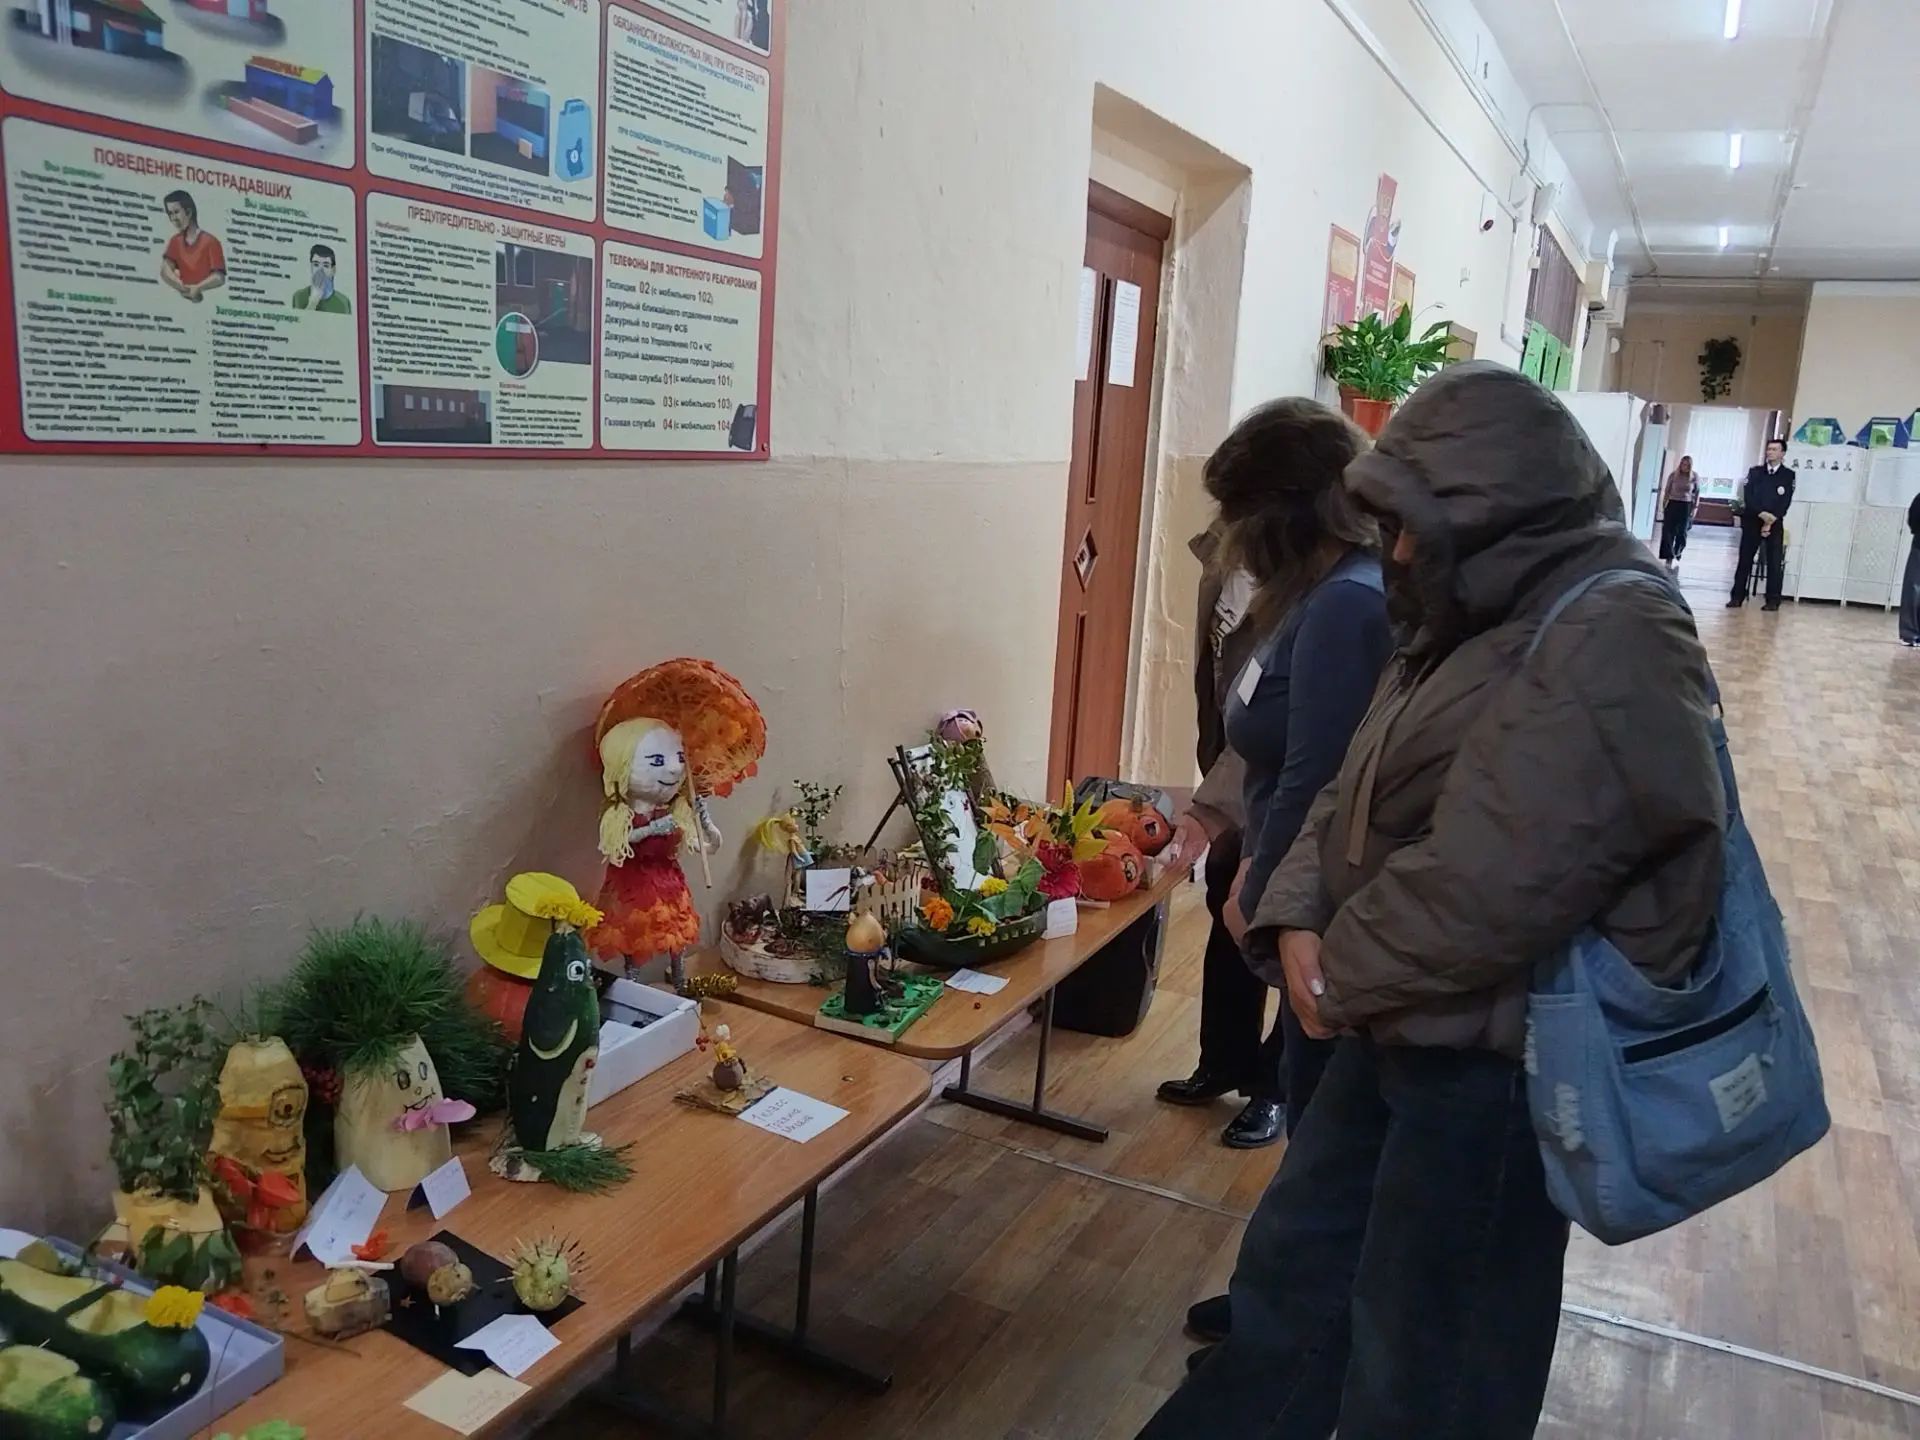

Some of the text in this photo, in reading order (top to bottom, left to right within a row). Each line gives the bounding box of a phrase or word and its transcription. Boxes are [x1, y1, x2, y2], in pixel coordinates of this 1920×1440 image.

[94, 148, 292, 200] ПОВЕДЕНИЕ ПОСТРАДАВШИХ
[408, 206, 495, 235] ПРЕДУПРЕДИТЕЛЬНО
[501, 225, 543, 244] ЗАЩИТНЫЕ
[545, 233, 566, 248] МЕРЫ
[609, 253, 757, 290] ТЕЛЕФОНЫ ДЛЯ ЭКСТРЕННОГО РЕАГИРОВАНИЯ
[639, 281, 649, 295] 02
[663, 374, 673, 385] 01
[663, 396, 673, 408] 03
[663, 418, 672, 430] 04
